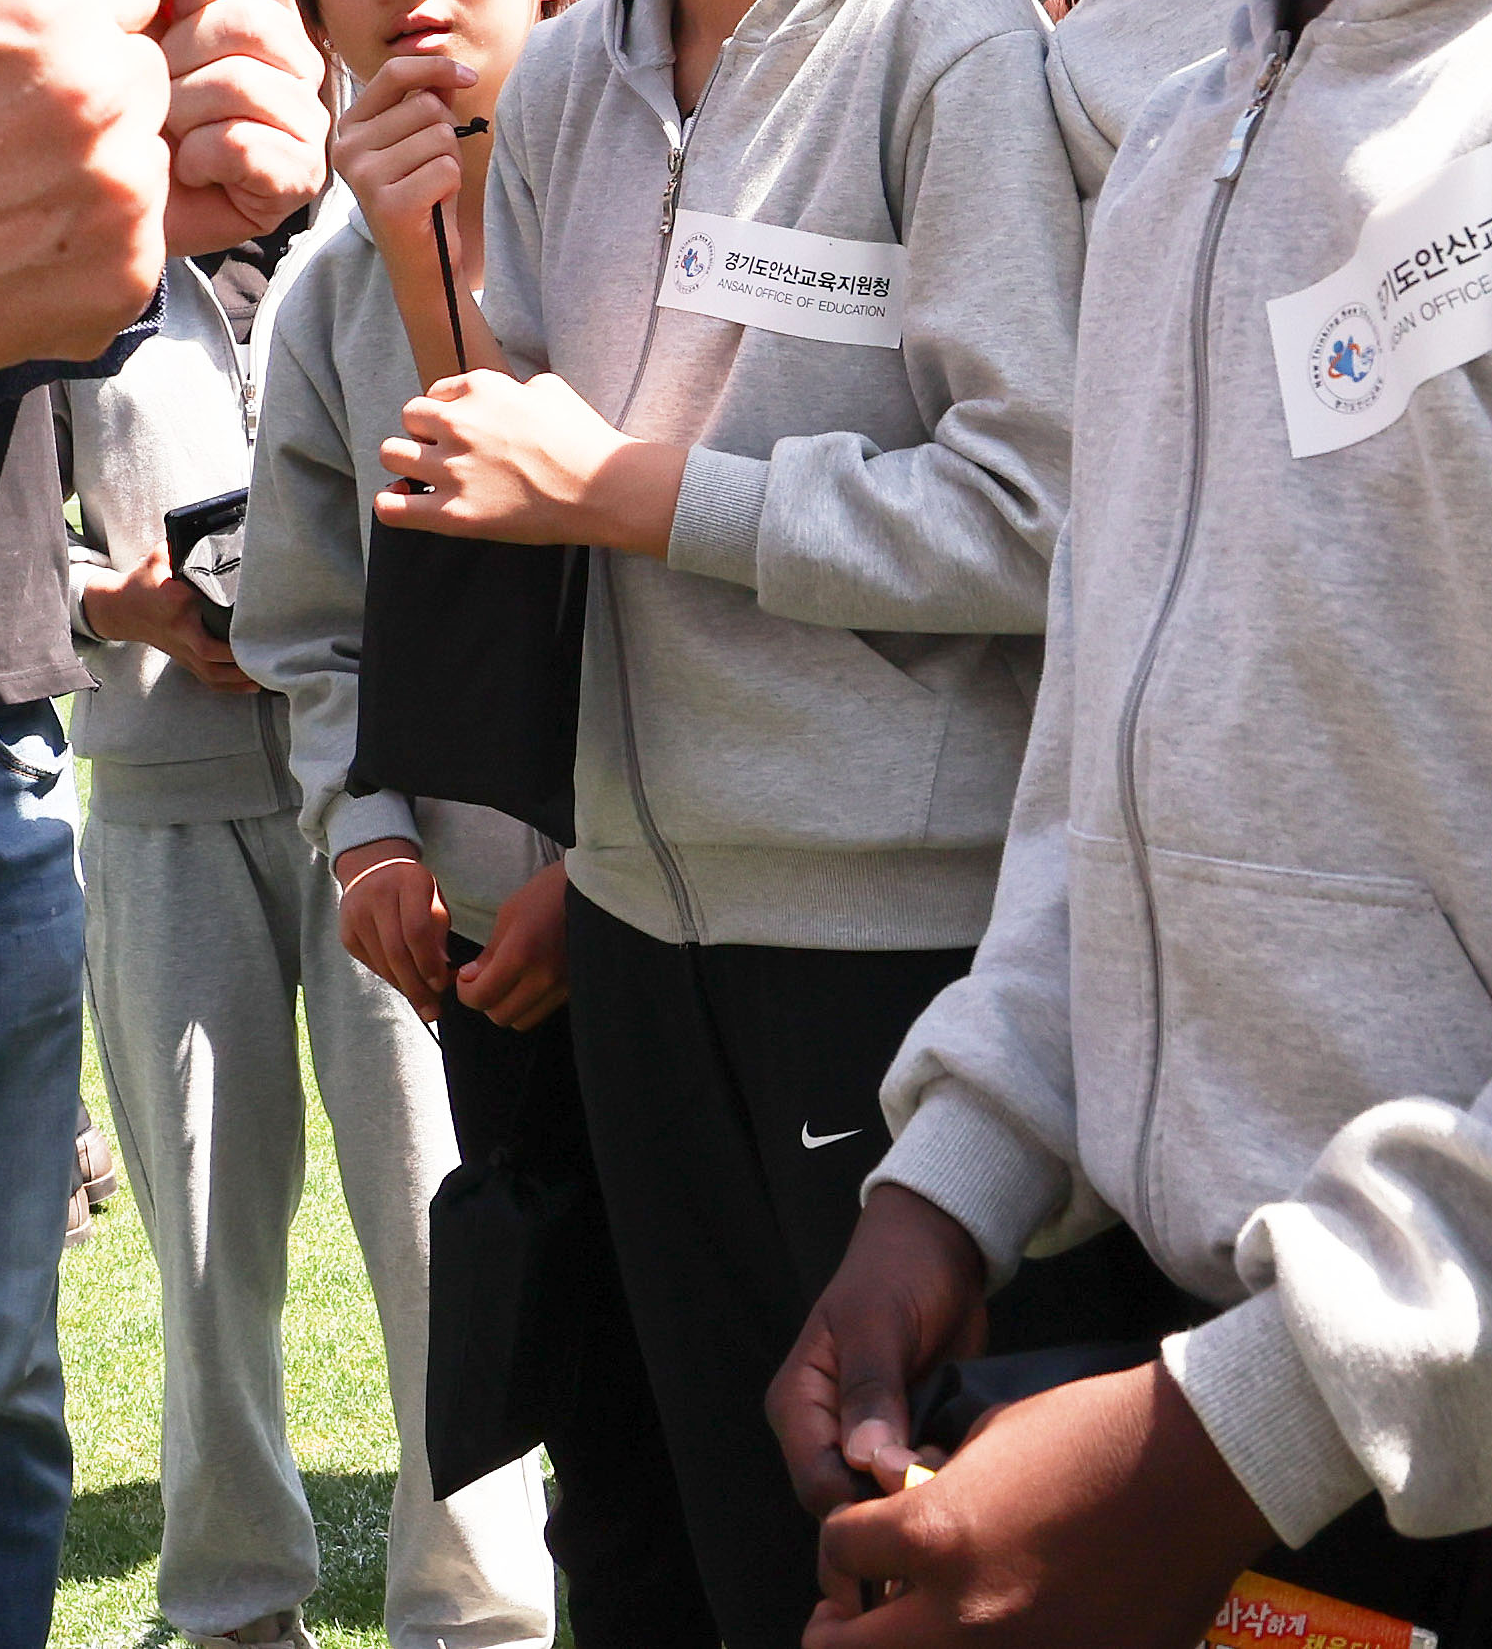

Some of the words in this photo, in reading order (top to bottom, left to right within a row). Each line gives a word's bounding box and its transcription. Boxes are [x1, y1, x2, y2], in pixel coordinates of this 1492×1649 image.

[724, 251, 891, 298] 경기도안산교육지원청
[717, 278, 754, 296] ANSAN
[755, 287, 794, 306] OFFICE
[796, 296, 816, 309] OF
[818, 300, 886, 318] EDUCATION
